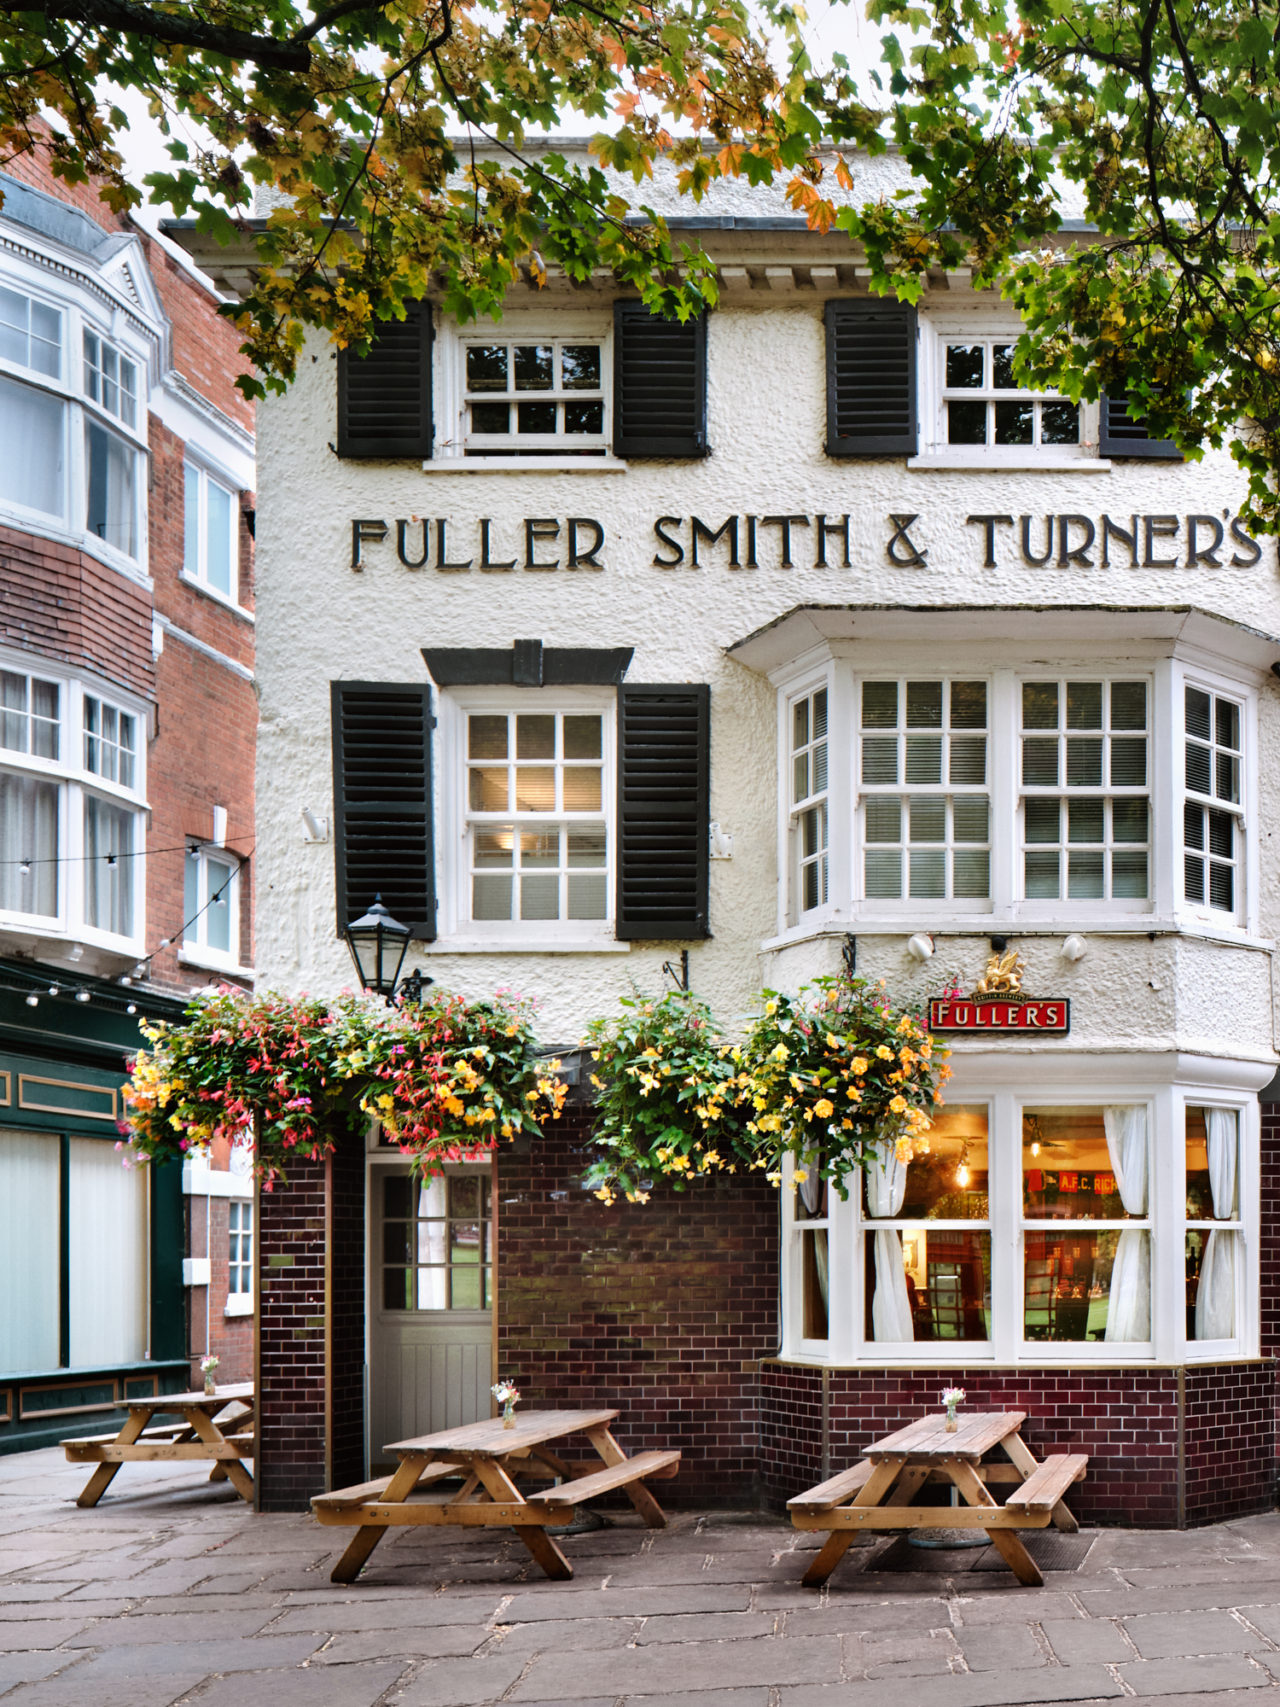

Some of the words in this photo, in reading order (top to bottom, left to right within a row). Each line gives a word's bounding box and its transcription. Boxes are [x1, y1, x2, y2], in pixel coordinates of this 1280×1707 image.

[351, 518, 604, 572] FULLER
[653, 515, 852, 570] SMITH
[887, 513, 928, 568] &
[967, 508, 1263, 568] TURNER'S
[937, 1003, 1058, 1028] FULLER'S
[1061, 1175, 1091, 1190] A.F.C.
